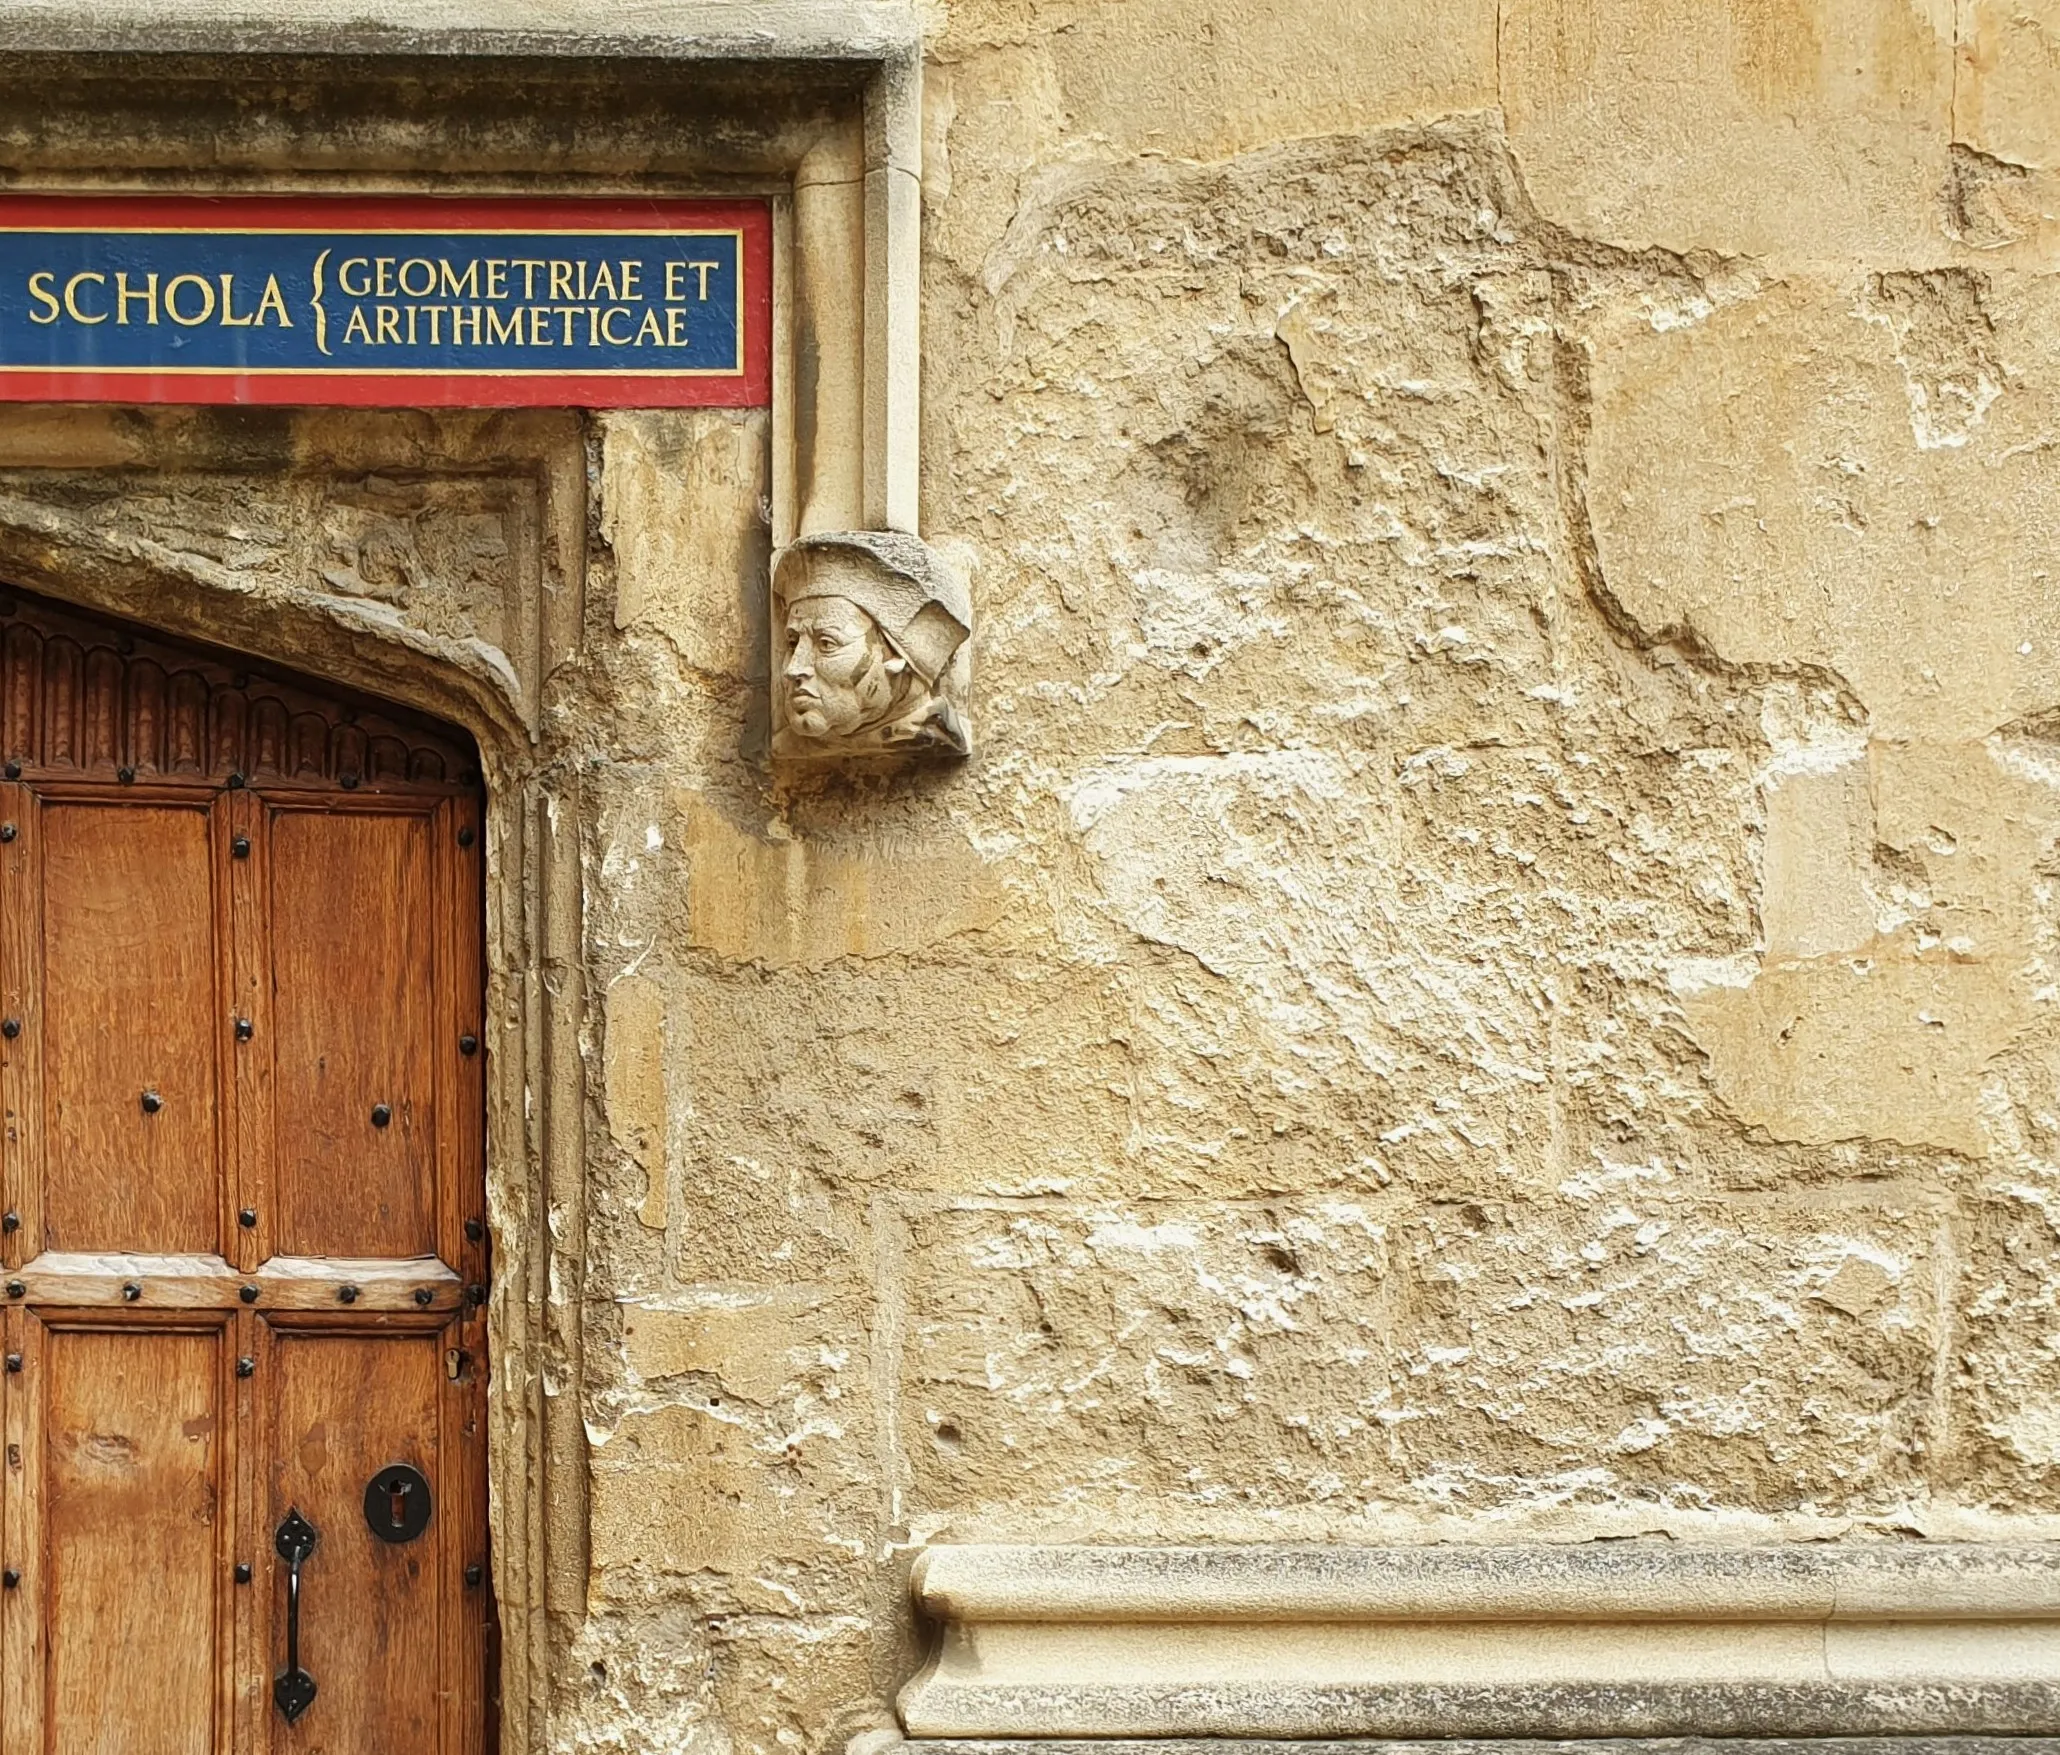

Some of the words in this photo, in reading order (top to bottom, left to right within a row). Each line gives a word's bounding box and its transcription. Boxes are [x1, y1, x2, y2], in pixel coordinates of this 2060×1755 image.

[28, 271, 294, 328] SCHOLA
[338, 257, 643, 301] GEOMETRIAE
[664, 261, 720, 302] ET
[342, 304, 689, 347] ARITHMETICAE
